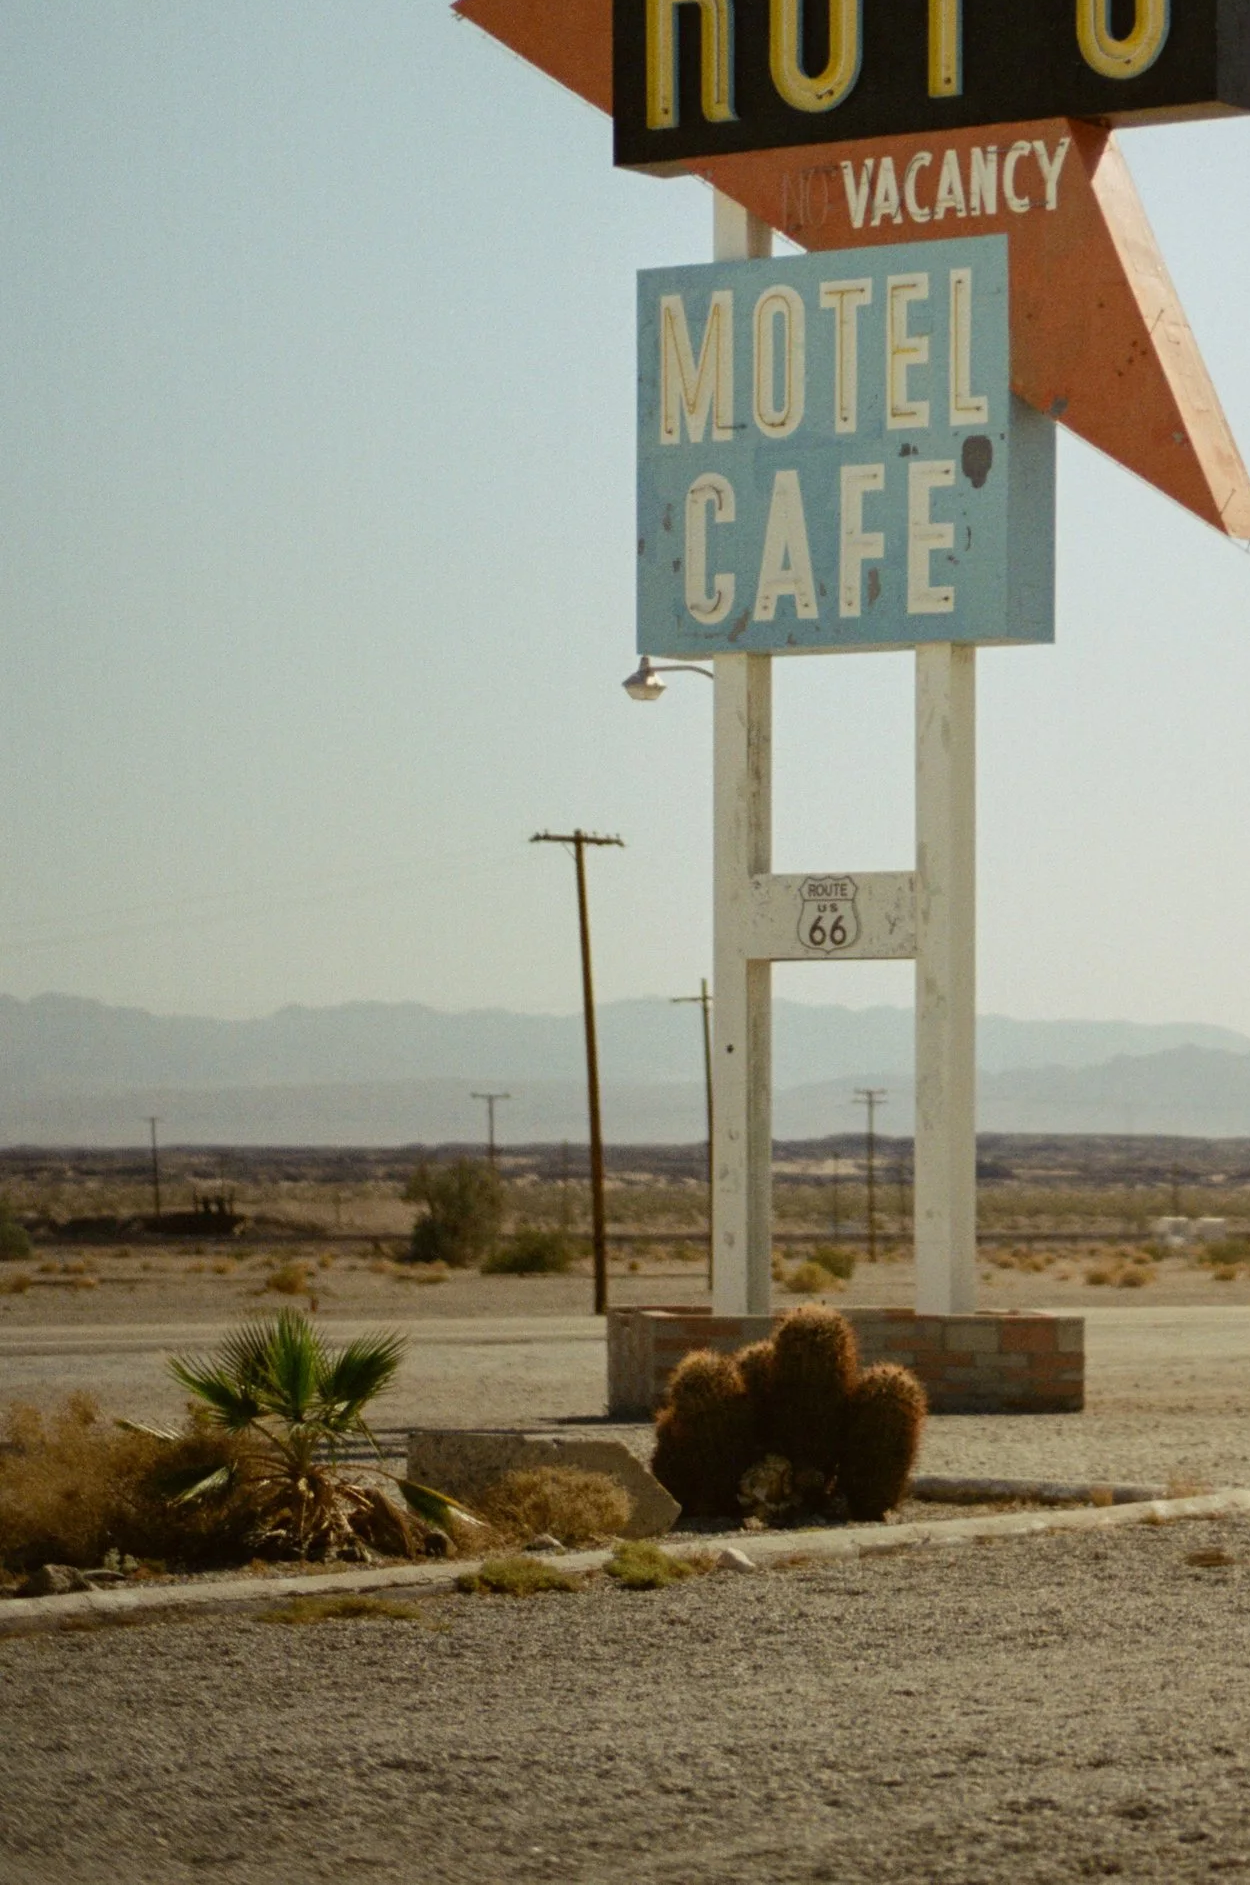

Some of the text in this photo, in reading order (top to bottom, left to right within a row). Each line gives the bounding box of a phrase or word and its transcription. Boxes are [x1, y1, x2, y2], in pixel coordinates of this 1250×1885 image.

[840, 137, 1072, 230] VACANCY
[658, 266, 989, 446] MOTEL
[684, 459, 956, 626] CAFE
[808, 883, 848, 897] ROUTE
[817, 902, 838, 913] US
[809, 915, 847, 946] 66
